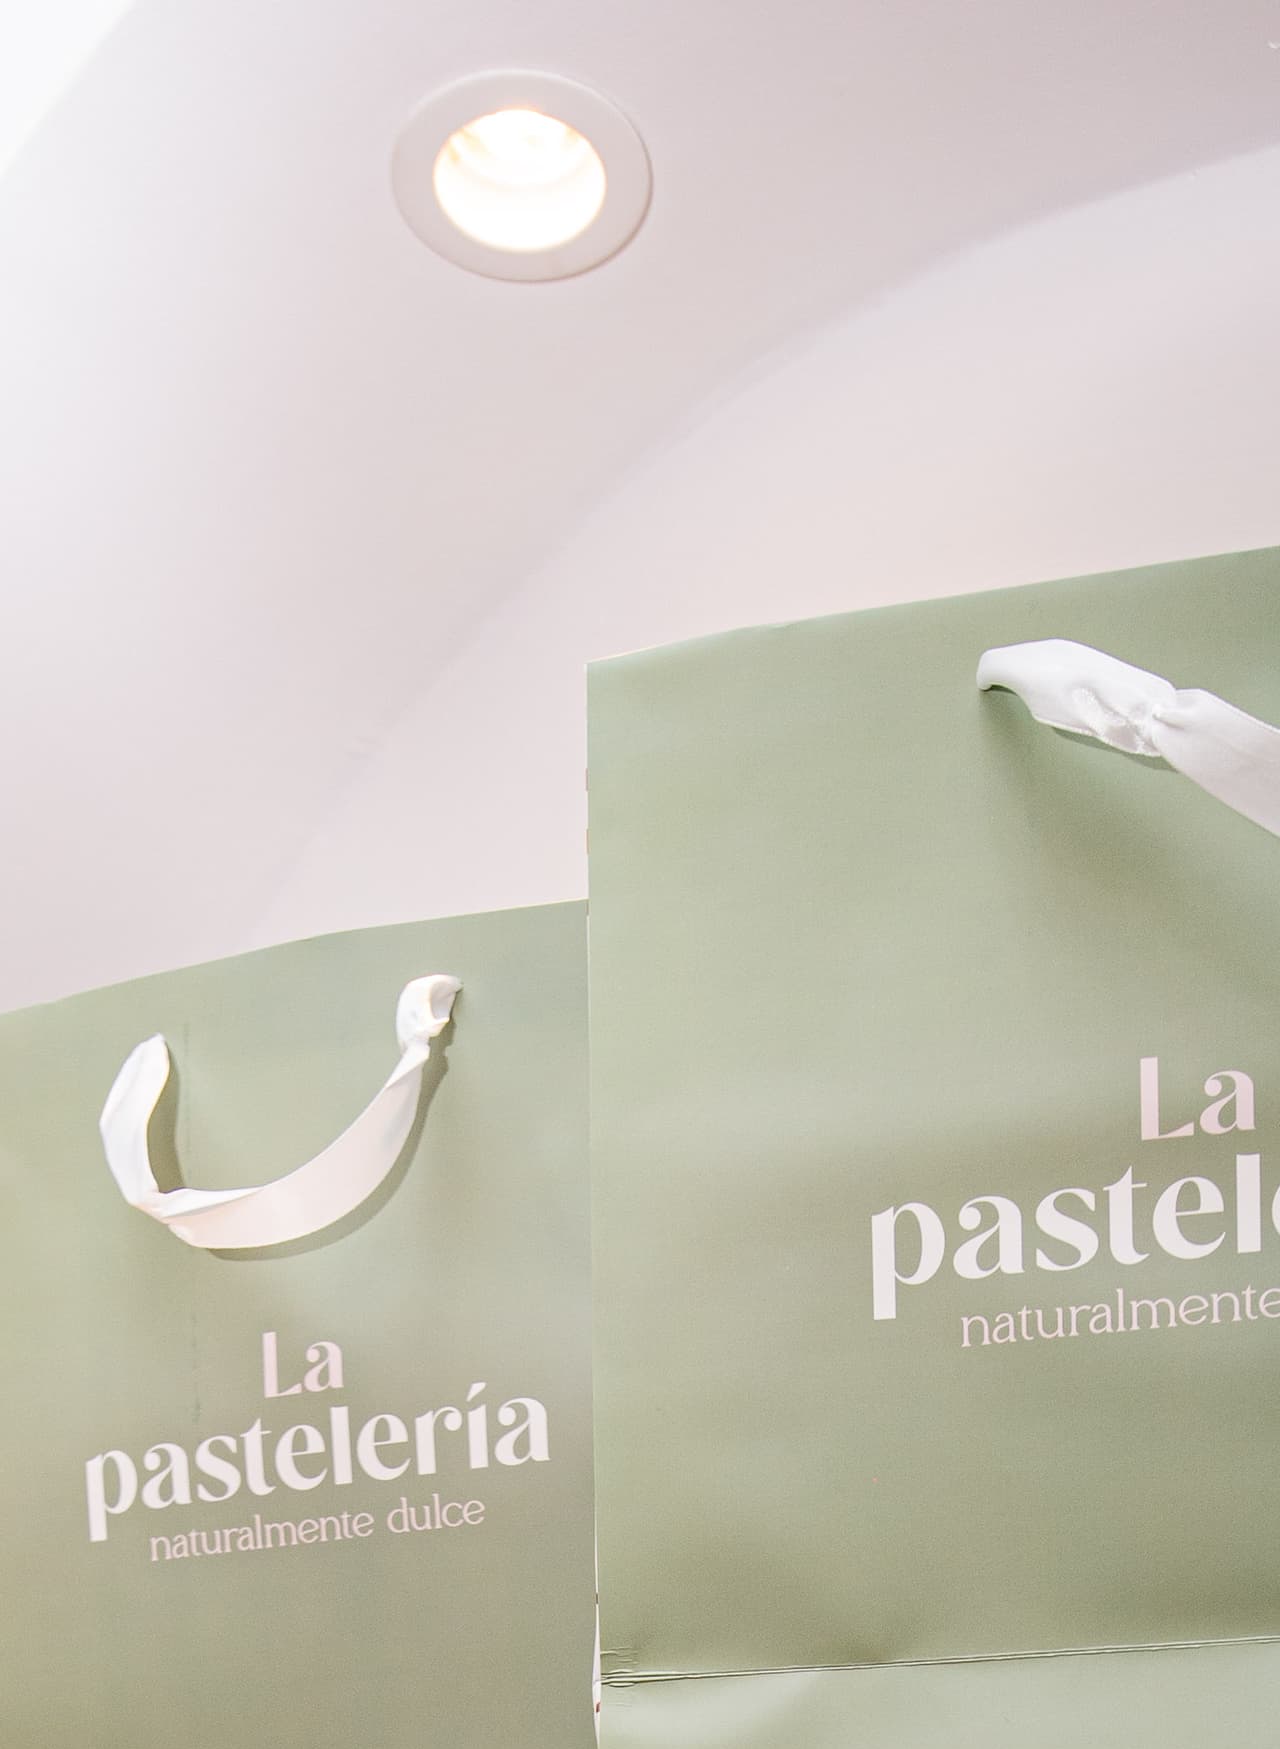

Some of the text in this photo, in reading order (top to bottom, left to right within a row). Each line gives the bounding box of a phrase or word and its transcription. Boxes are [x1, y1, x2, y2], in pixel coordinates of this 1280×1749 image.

[1140, 1057, 1255, 1140] La
[261, 1331, 344, 1398] La
[84, 1382, 551, 1542] pastelería
[149, 1494, 485, 1561] naturalmente dulce
